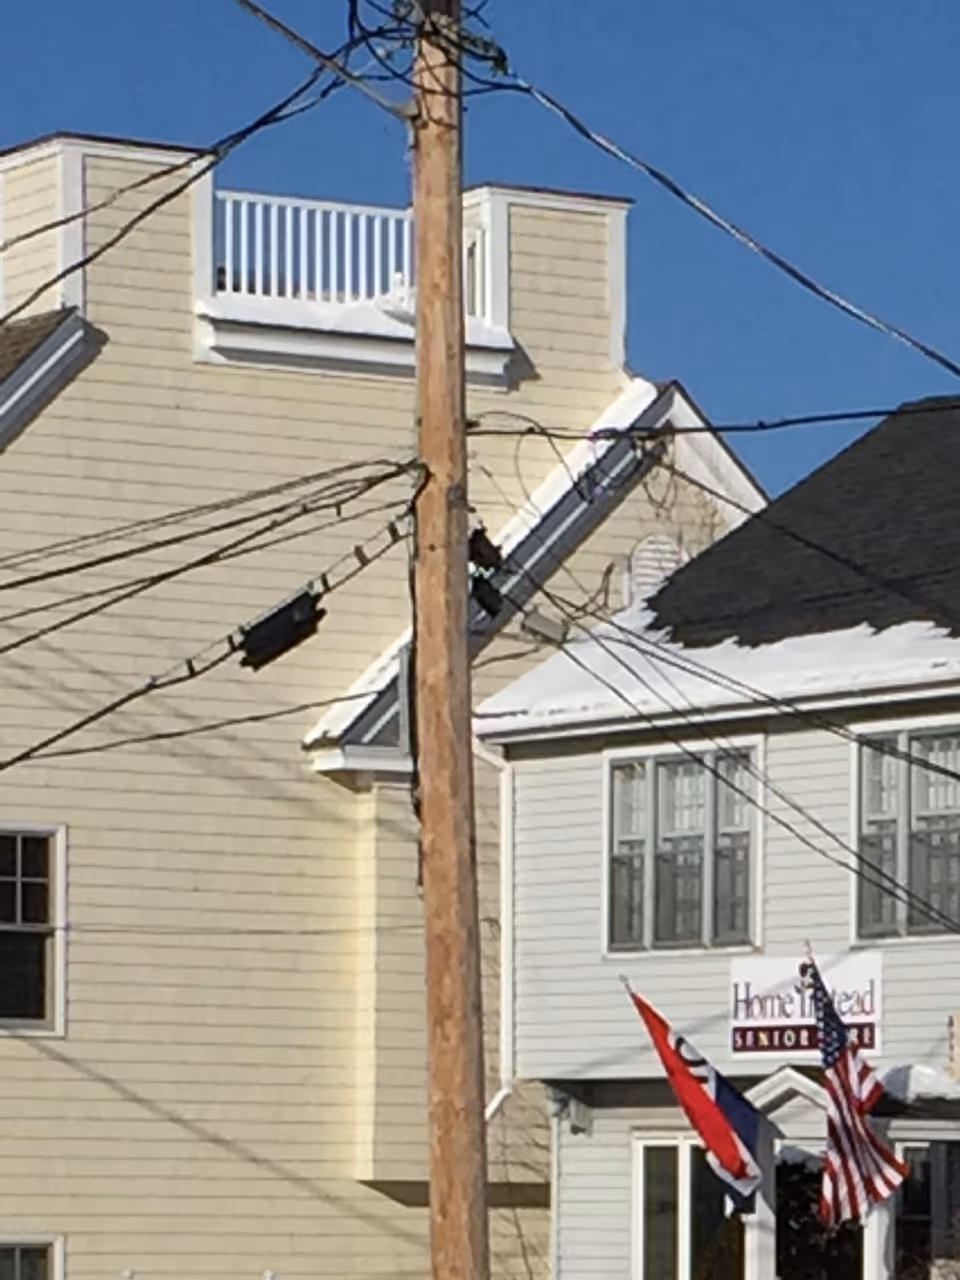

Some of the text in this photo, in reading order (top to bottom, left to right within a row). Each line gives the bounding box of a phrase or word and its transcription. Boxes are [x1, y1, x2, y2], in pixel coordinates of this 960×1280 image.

[733, 978, 876, 1021] Home Intead
[734, 1030, 809, 1048] SENIOR
